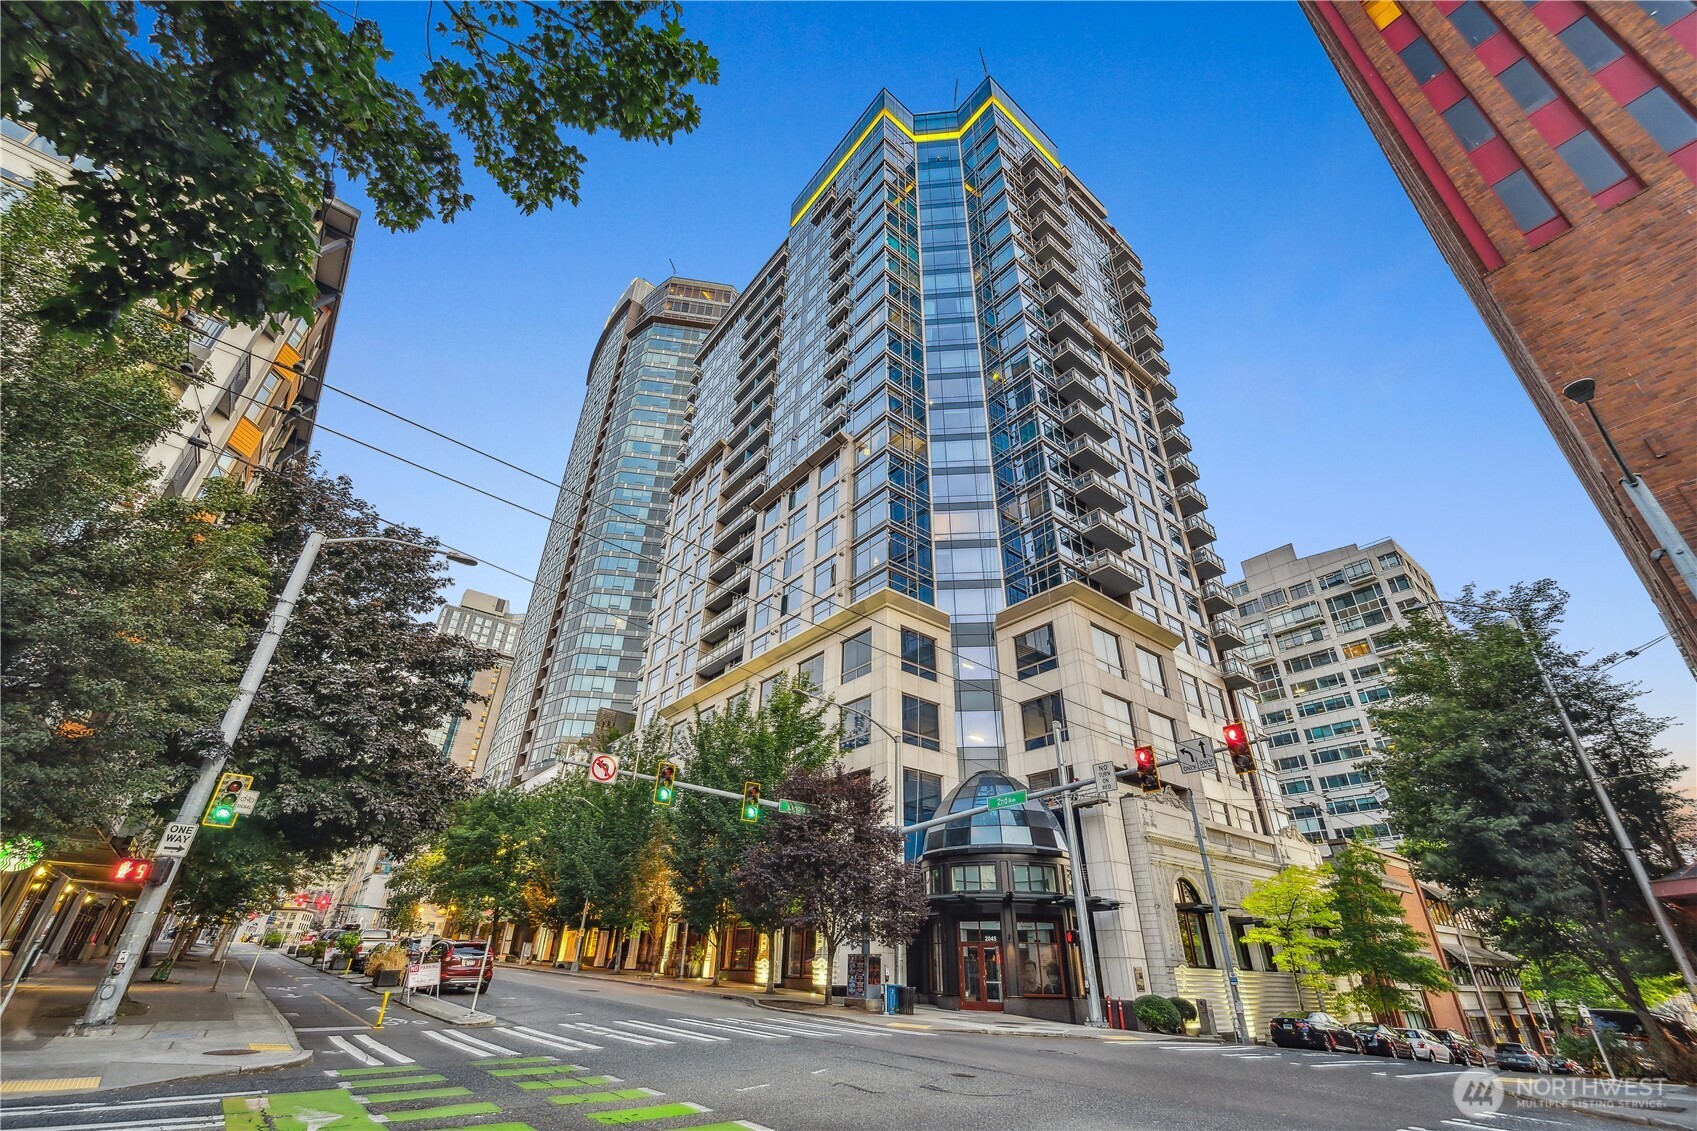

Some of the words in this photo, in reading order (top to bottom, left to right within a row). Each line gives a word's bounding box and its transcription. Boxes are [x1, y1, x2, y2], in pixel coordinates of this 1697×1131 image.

[1199, 758, 1213, 766] ONLY
[997, 797, 1007, 806] 2nd
[170, 825, 195, 835] ONE
[165, 834, 191, 844] WAY
[410, 965, 419, 973] NO
